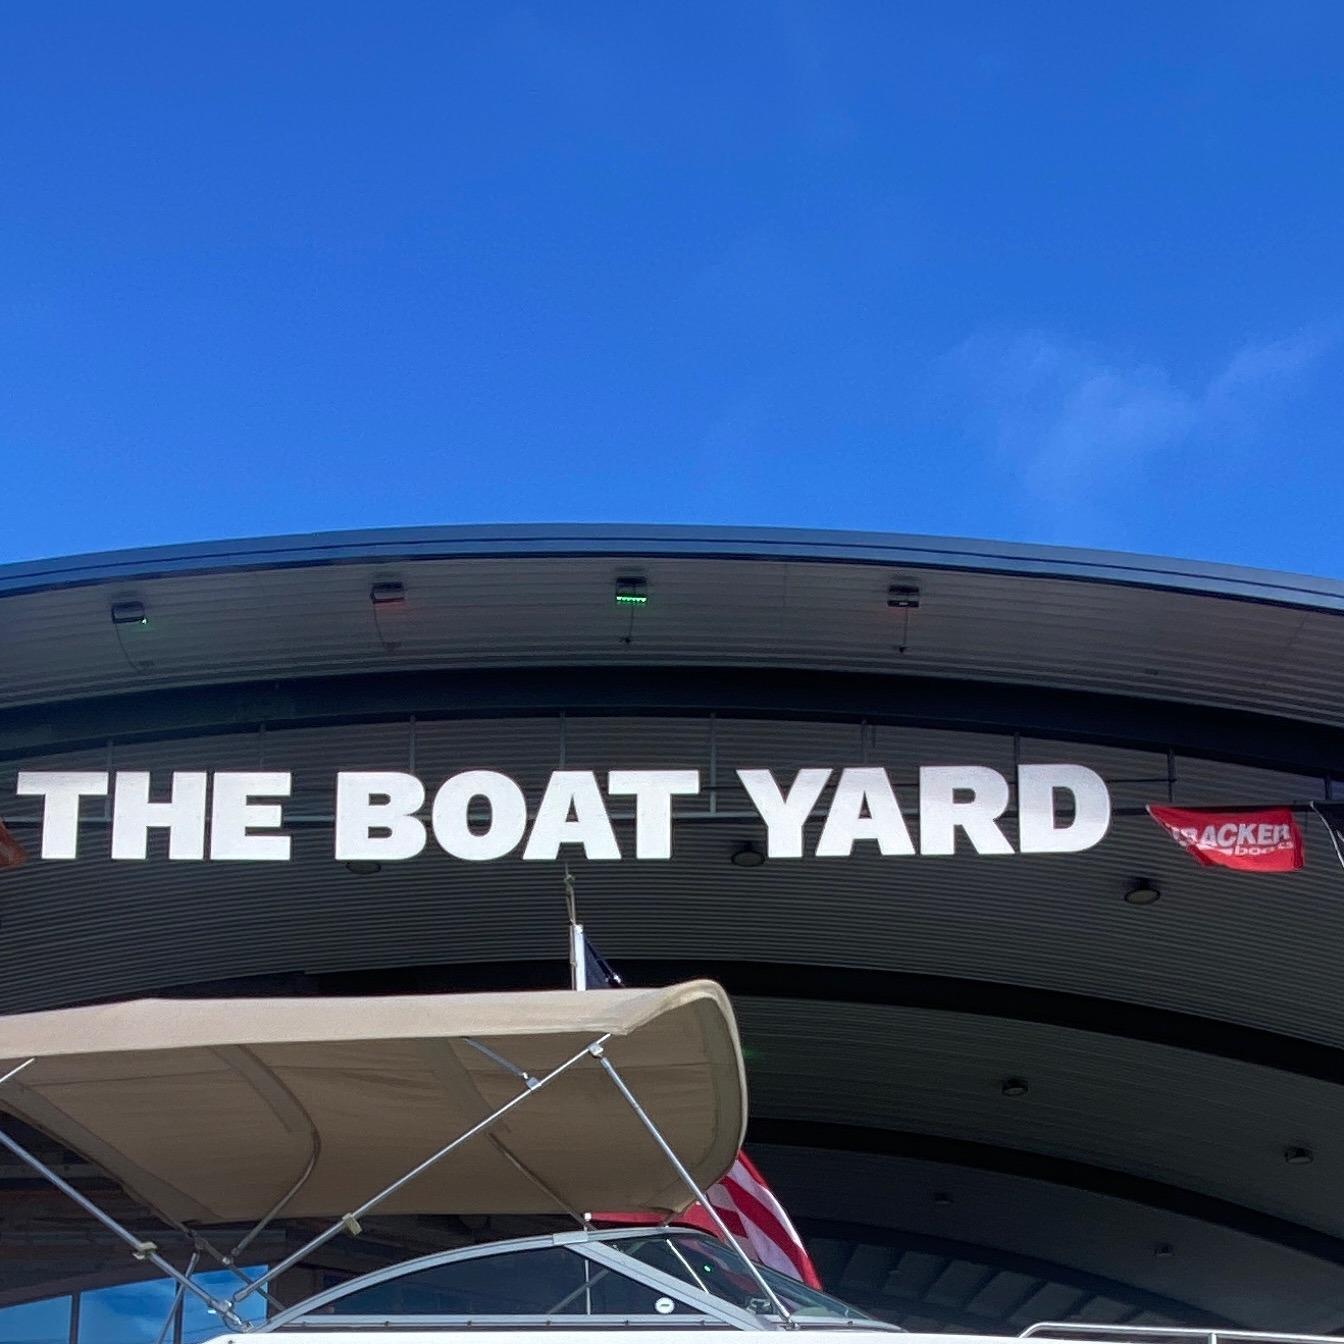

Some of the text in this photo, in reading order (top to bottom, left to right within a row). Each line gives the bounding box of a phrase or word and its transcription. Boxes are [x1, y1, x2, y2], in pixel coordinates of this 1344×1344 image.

[17, 763, 1111, 861] THE BOAT YARD
